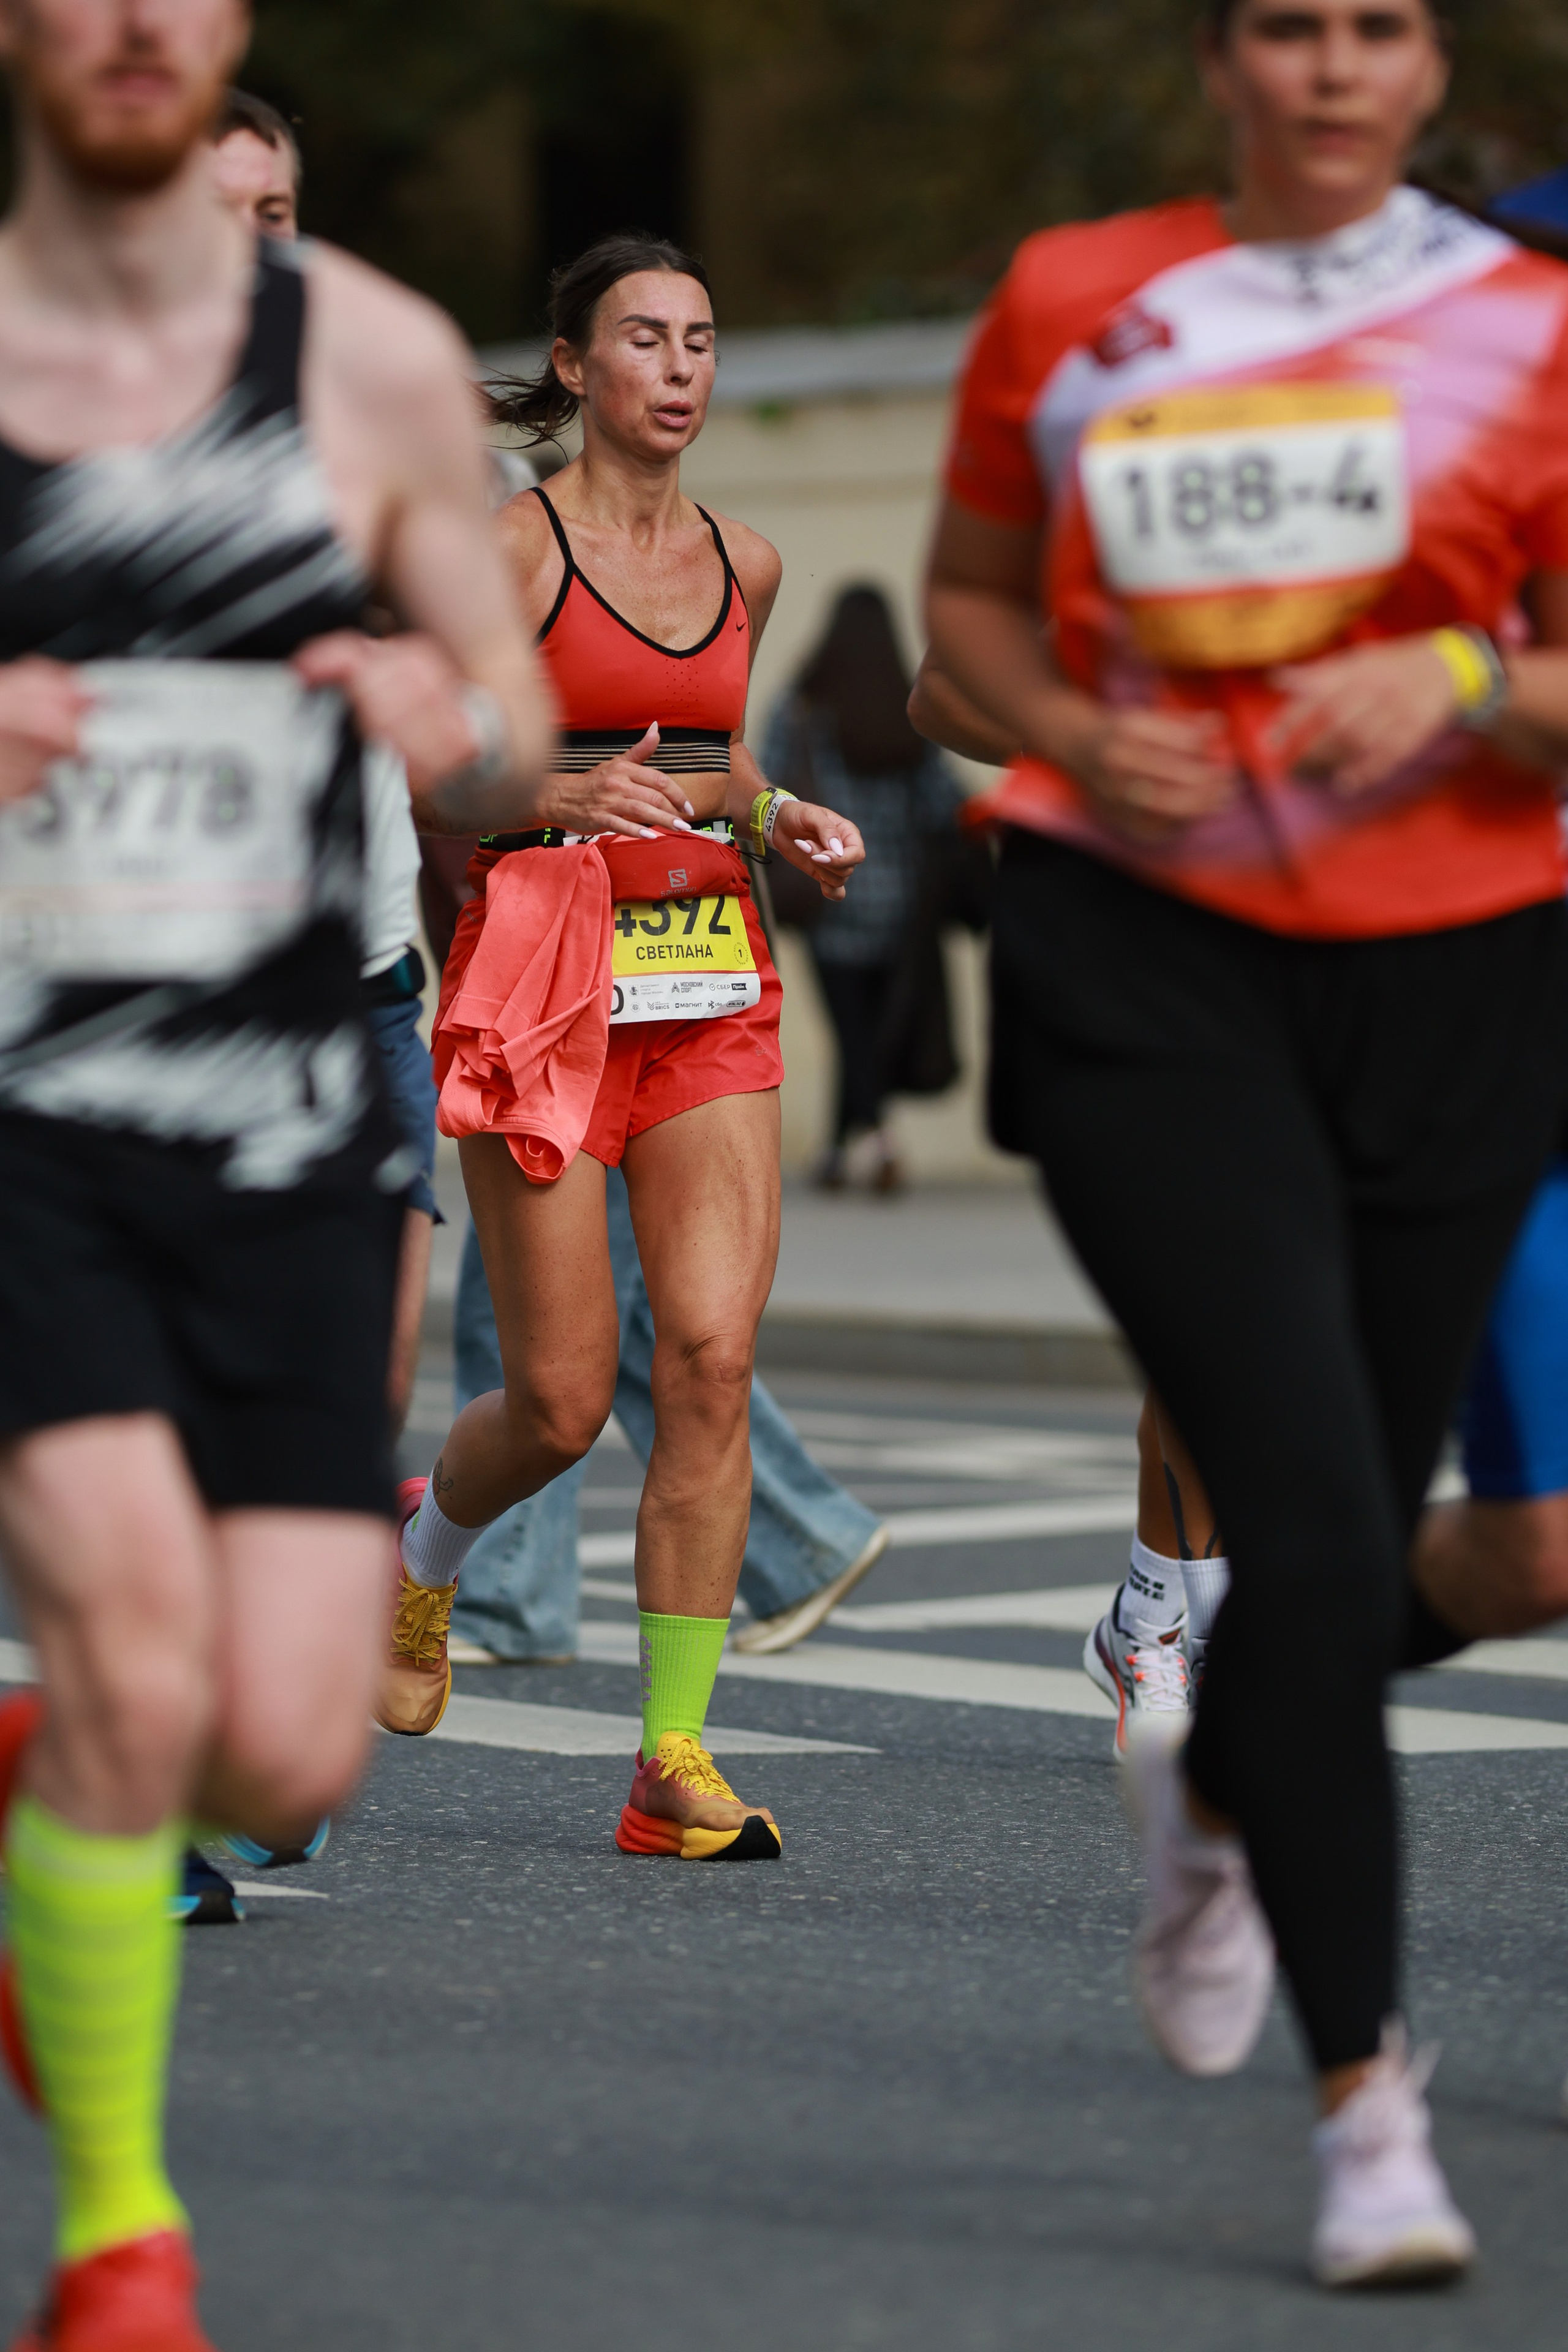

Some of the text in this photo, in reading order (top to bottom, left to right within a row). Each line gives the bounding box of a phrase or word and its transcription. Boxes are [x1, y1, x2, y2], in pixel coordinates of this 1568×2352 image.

[766, 803, 778, 832] 4392
[636, 944, 714, 960] СВЕТЛАНА
[738, 949, 742, 958] 1
